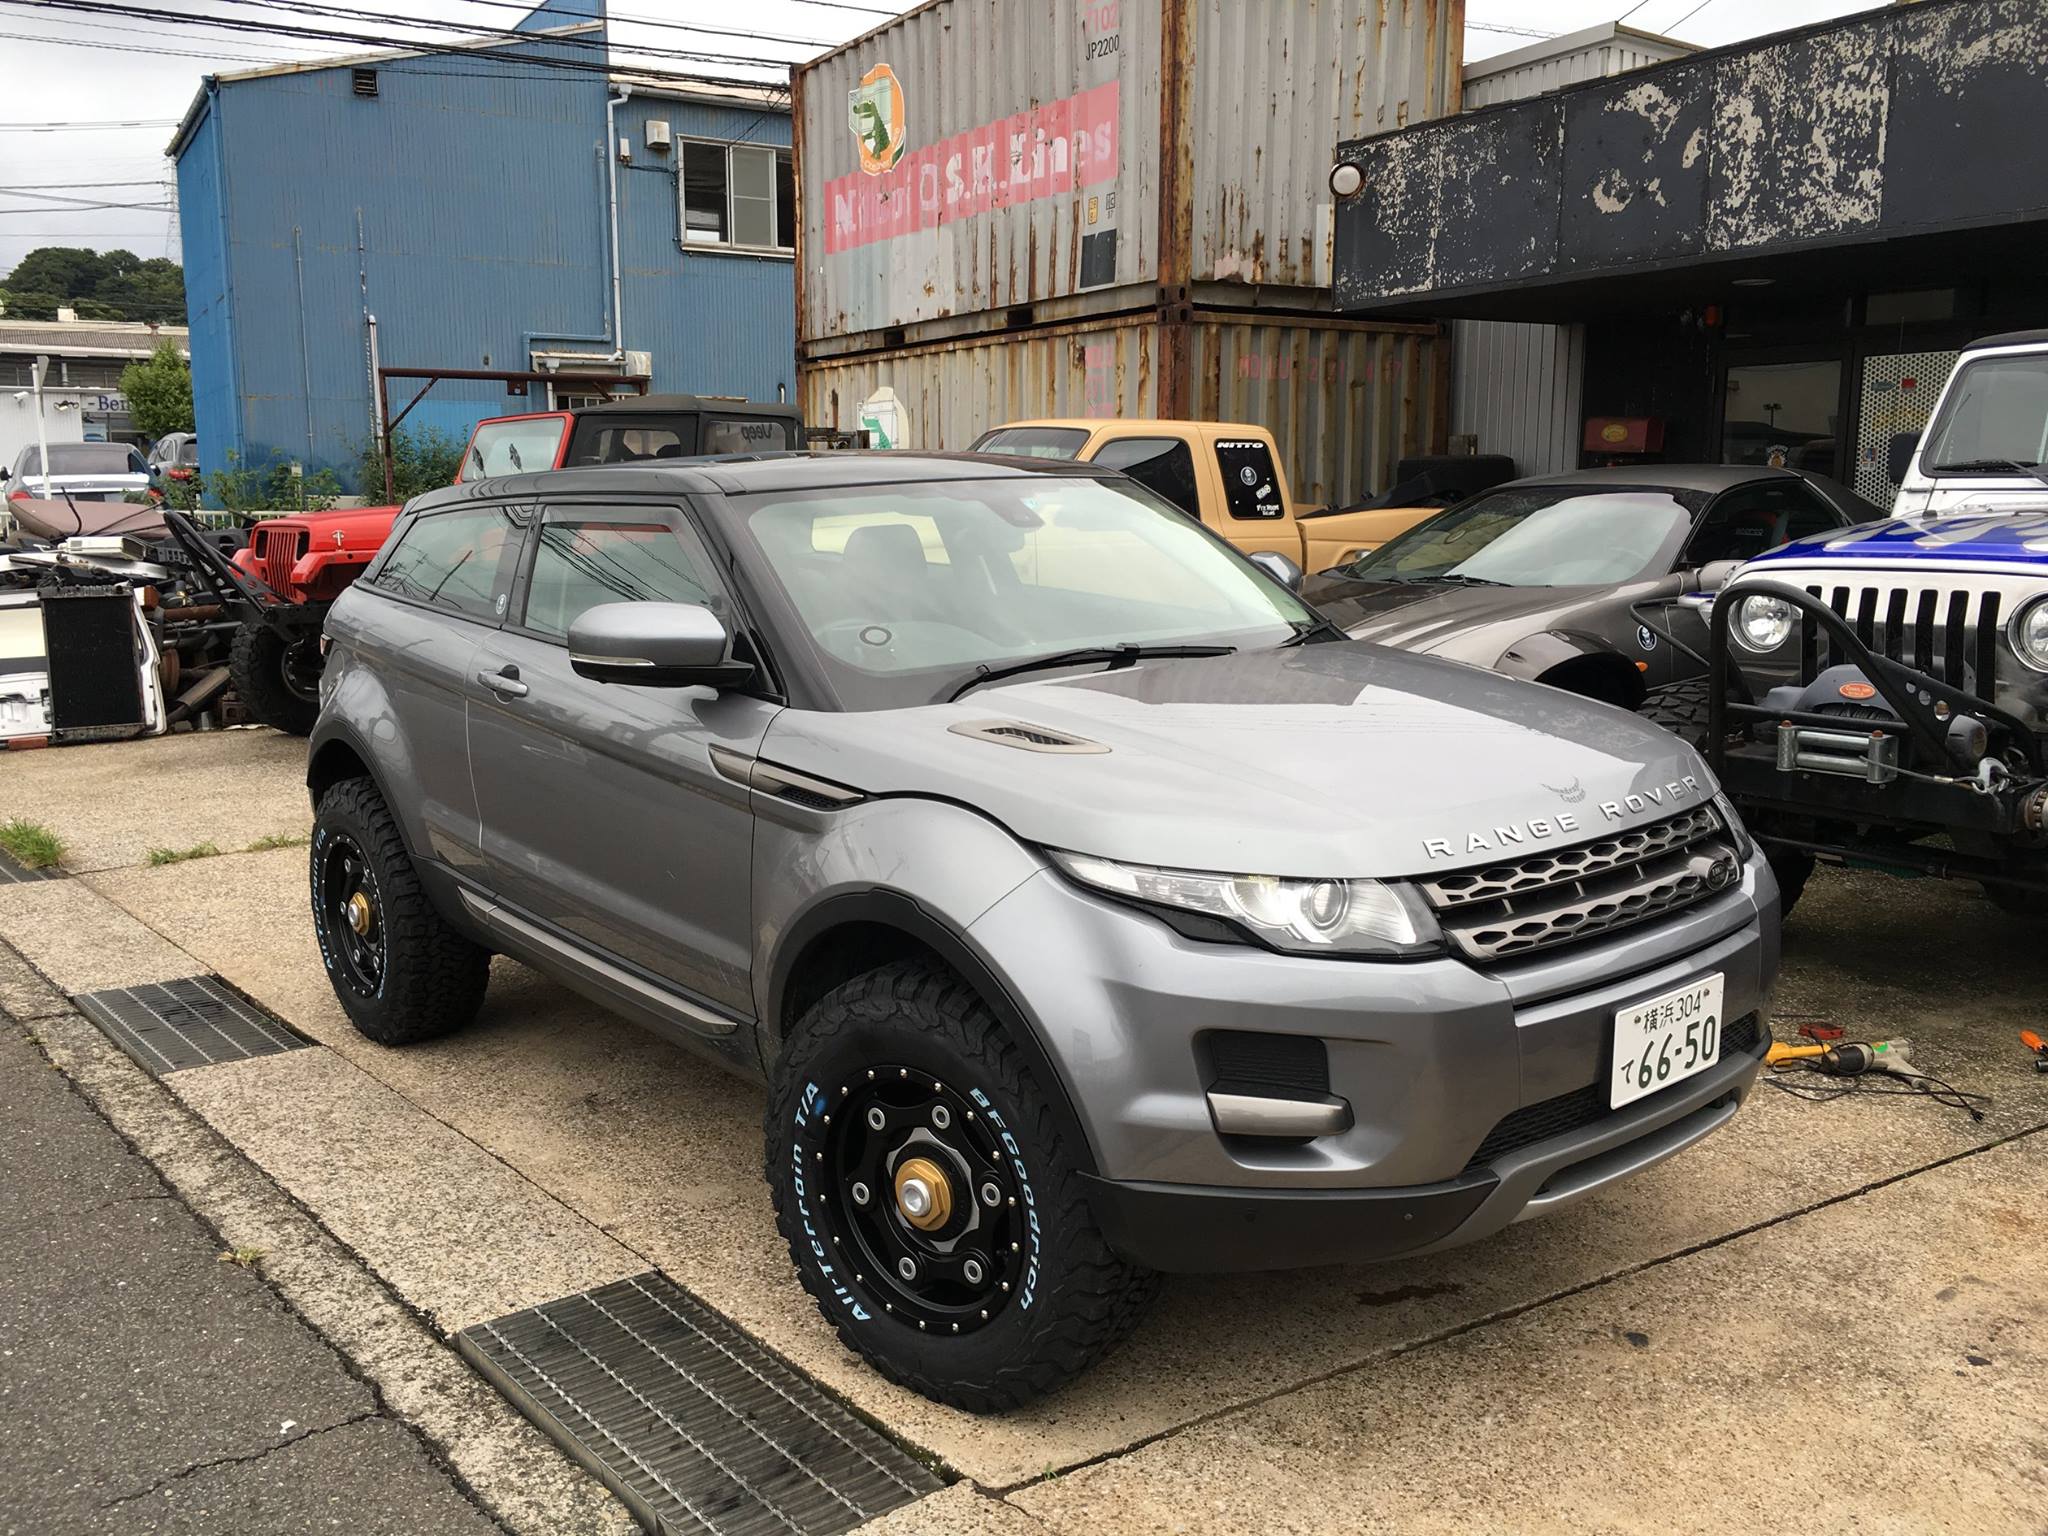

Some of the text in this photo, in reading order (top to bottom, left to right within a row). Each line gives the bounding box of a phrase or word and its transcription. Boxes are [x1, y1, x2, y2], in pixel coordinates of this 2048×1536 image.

[1086, 34, 1120, 61] JP2200
[1422, 812, 1580, 858] RANGE
[1599, 775, 1701, 821] ROVER
[1643, 989, 1701, 1034] 横浜 304
[1620, 1015, 1716, 1089] て 66-50
[792, 1082, 871, 1321] All-Terrain T/A
[969, 1088, 1041, 1310] BFGoodrich
